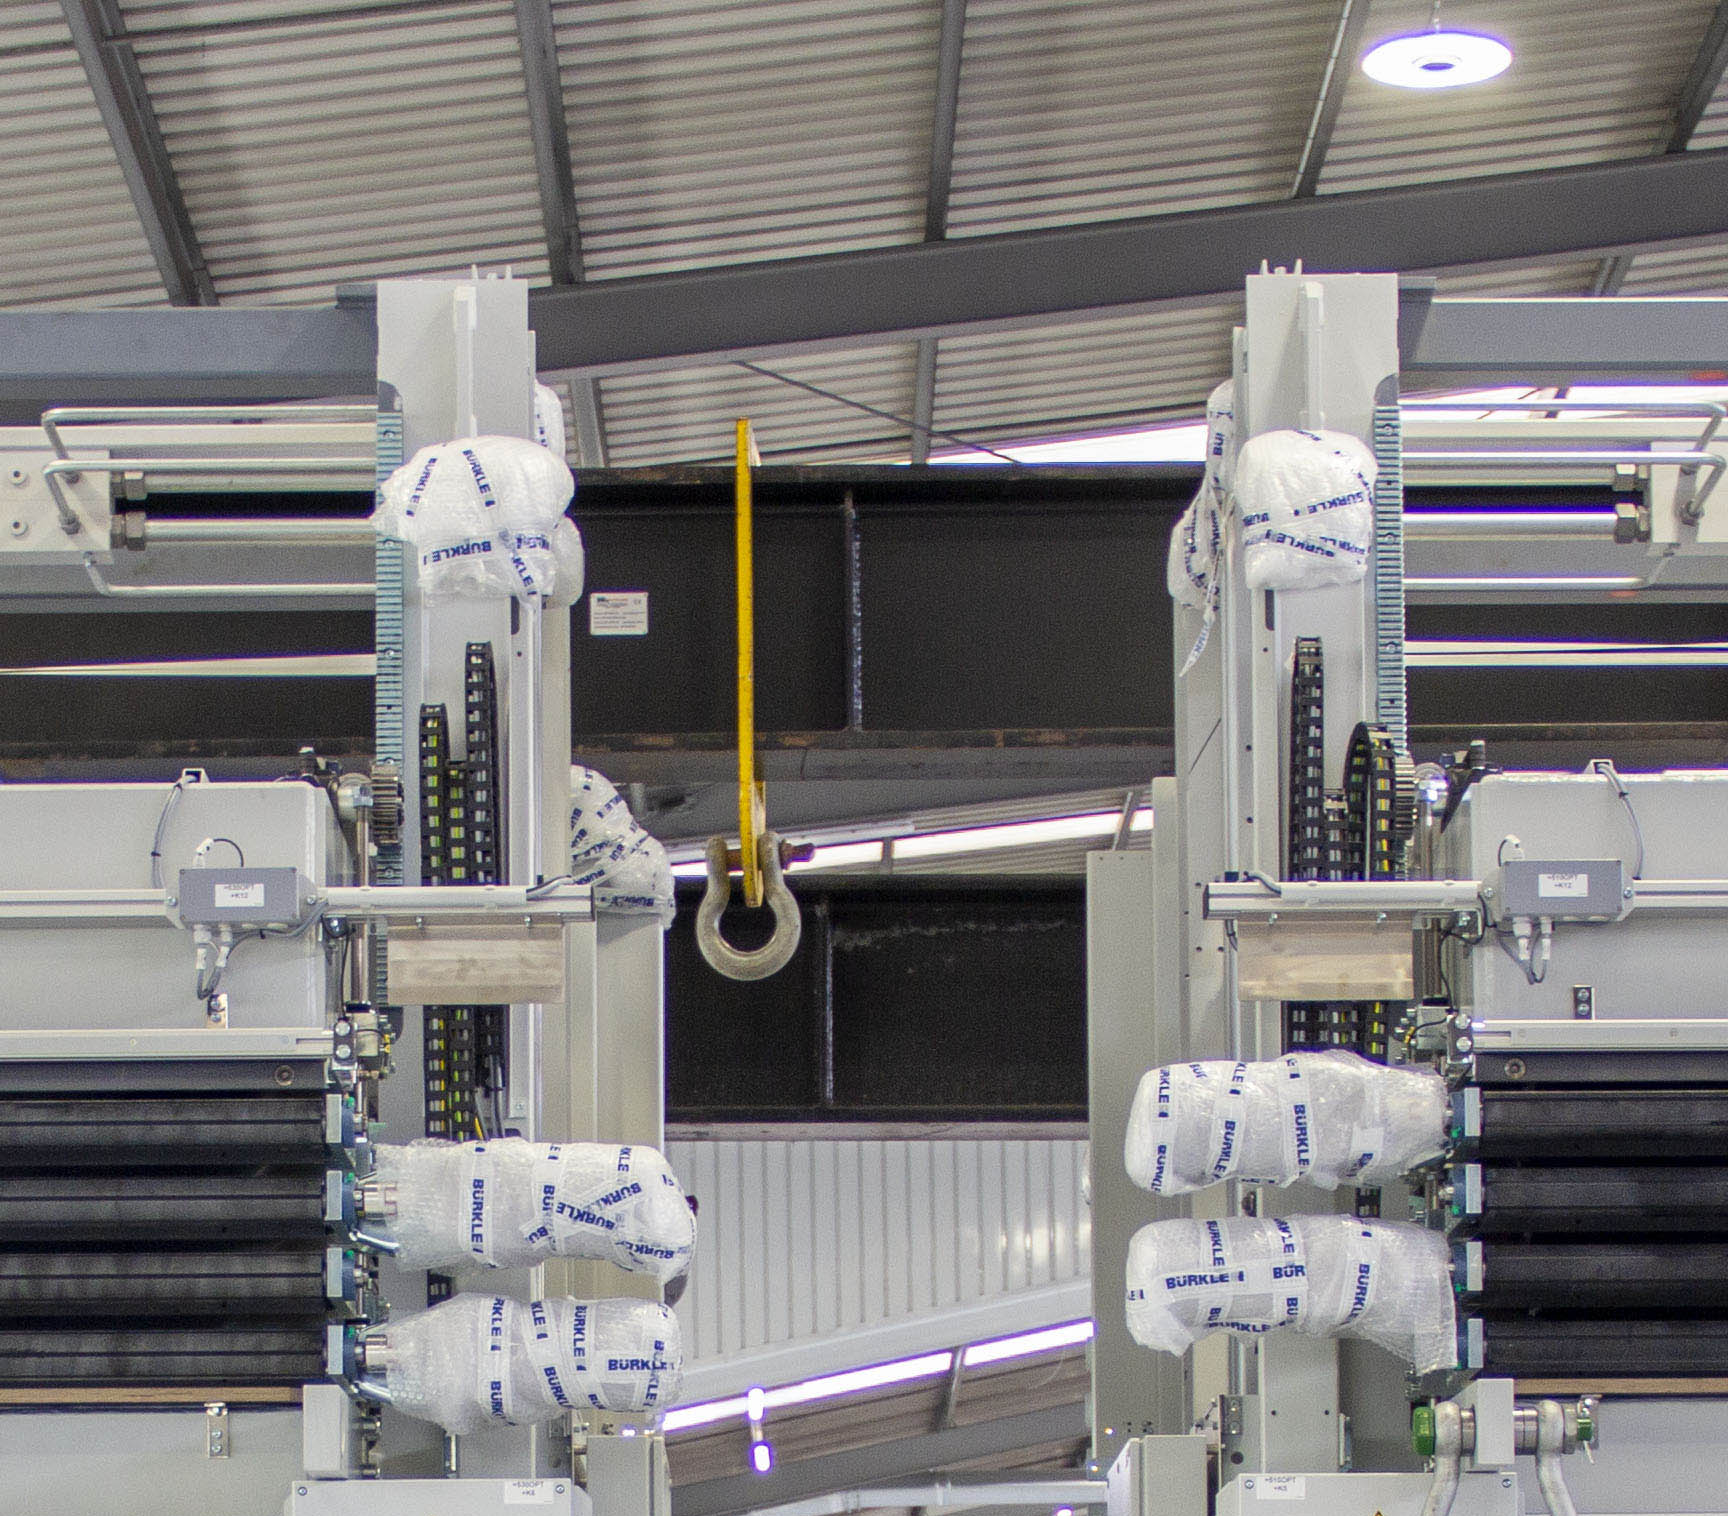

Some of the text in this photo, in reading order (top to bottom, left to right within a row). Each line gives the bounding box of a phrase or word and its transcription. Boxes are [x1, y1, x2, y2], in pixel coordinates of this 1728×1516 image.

[1293, 1104, 1310, 1166] BÜRKLE
[471, 1178, 484, 1244] BÜRKLE
[556, 1202, 616, 1230] BÜRKLE
[1165, 1273, 1229, 1290] BÜRKLE
[573, 1306, 588, 1357] BÜRKLE
